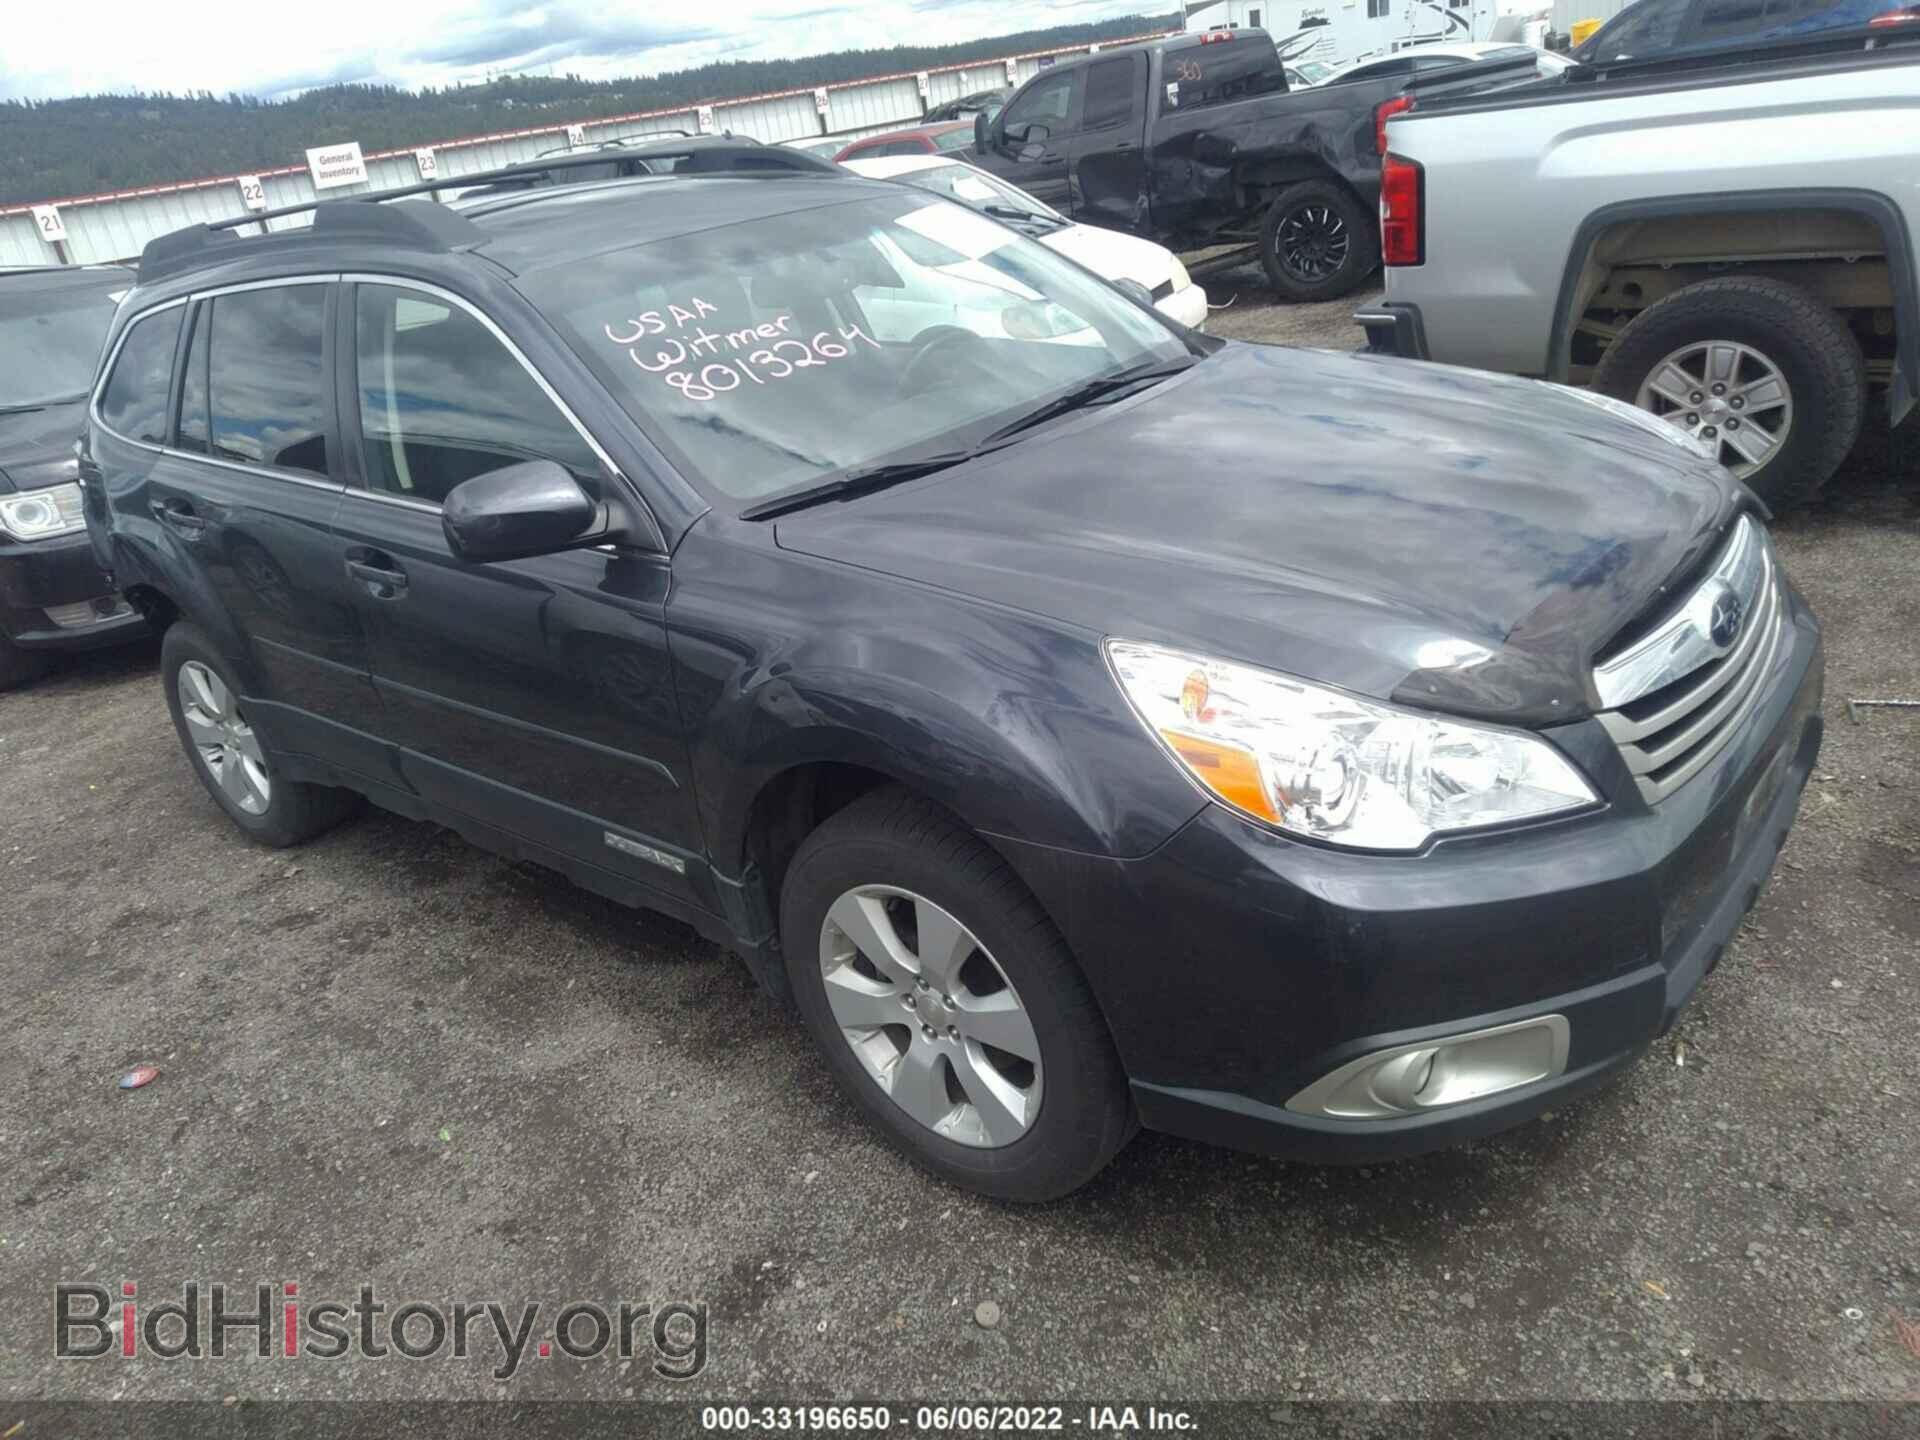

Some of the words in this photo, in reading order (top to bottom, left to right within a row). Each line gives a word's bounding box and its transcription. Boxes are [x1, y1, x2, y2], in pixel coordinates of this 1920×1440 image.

[700, 112, 713, 126] 25
[319, 152, 353, 165] General
[419, 156, 436, 171] 23
[319, 167, 360, 180] Inventory
[243, 183, 263, 200] 22
[40, 213, 61, 232] 21
[604, 296, 718, 344] USAA
[629, 314, 792, 372] Witmer
